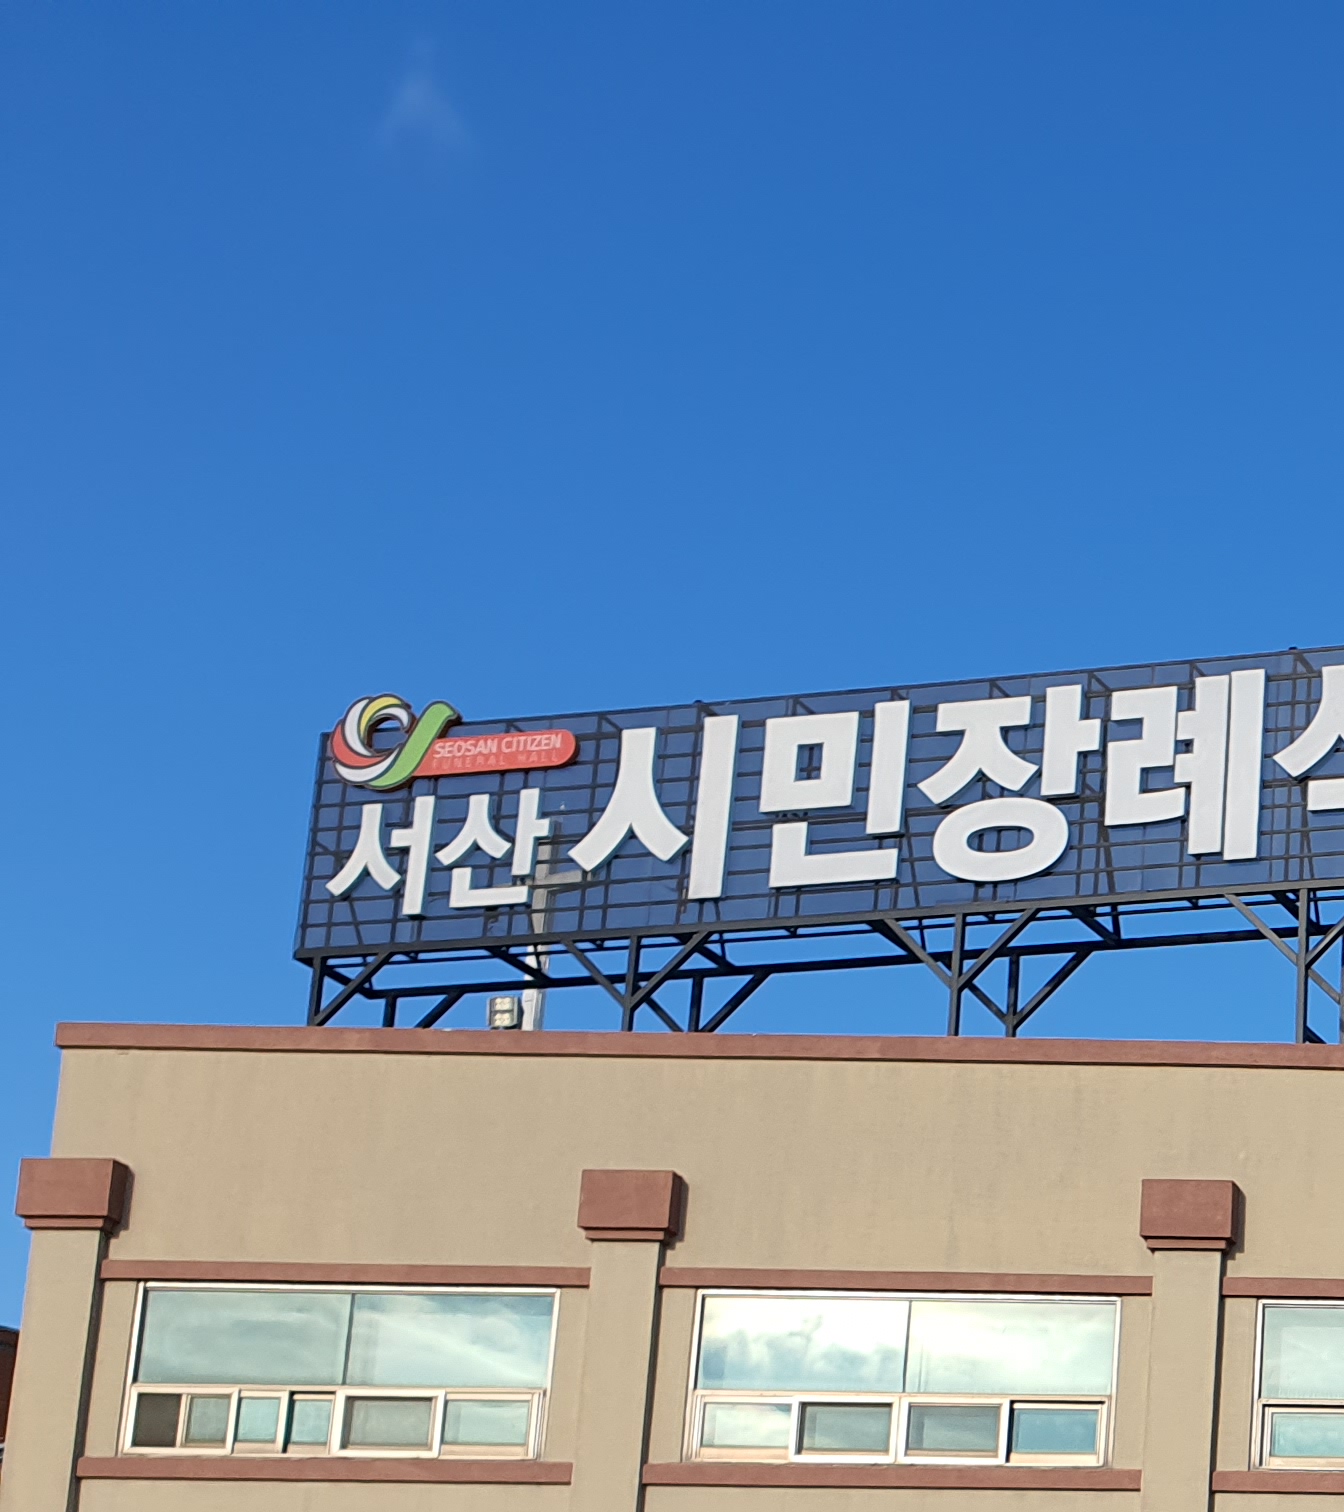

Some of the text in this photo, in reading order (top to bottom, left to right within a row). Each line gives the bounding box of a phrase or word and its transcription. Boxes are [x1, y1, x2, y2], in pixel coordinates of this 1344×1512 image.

[433, 733, 563, 758] SEOSAN CITIZEN
[518, 751, 559, 764] HALL
